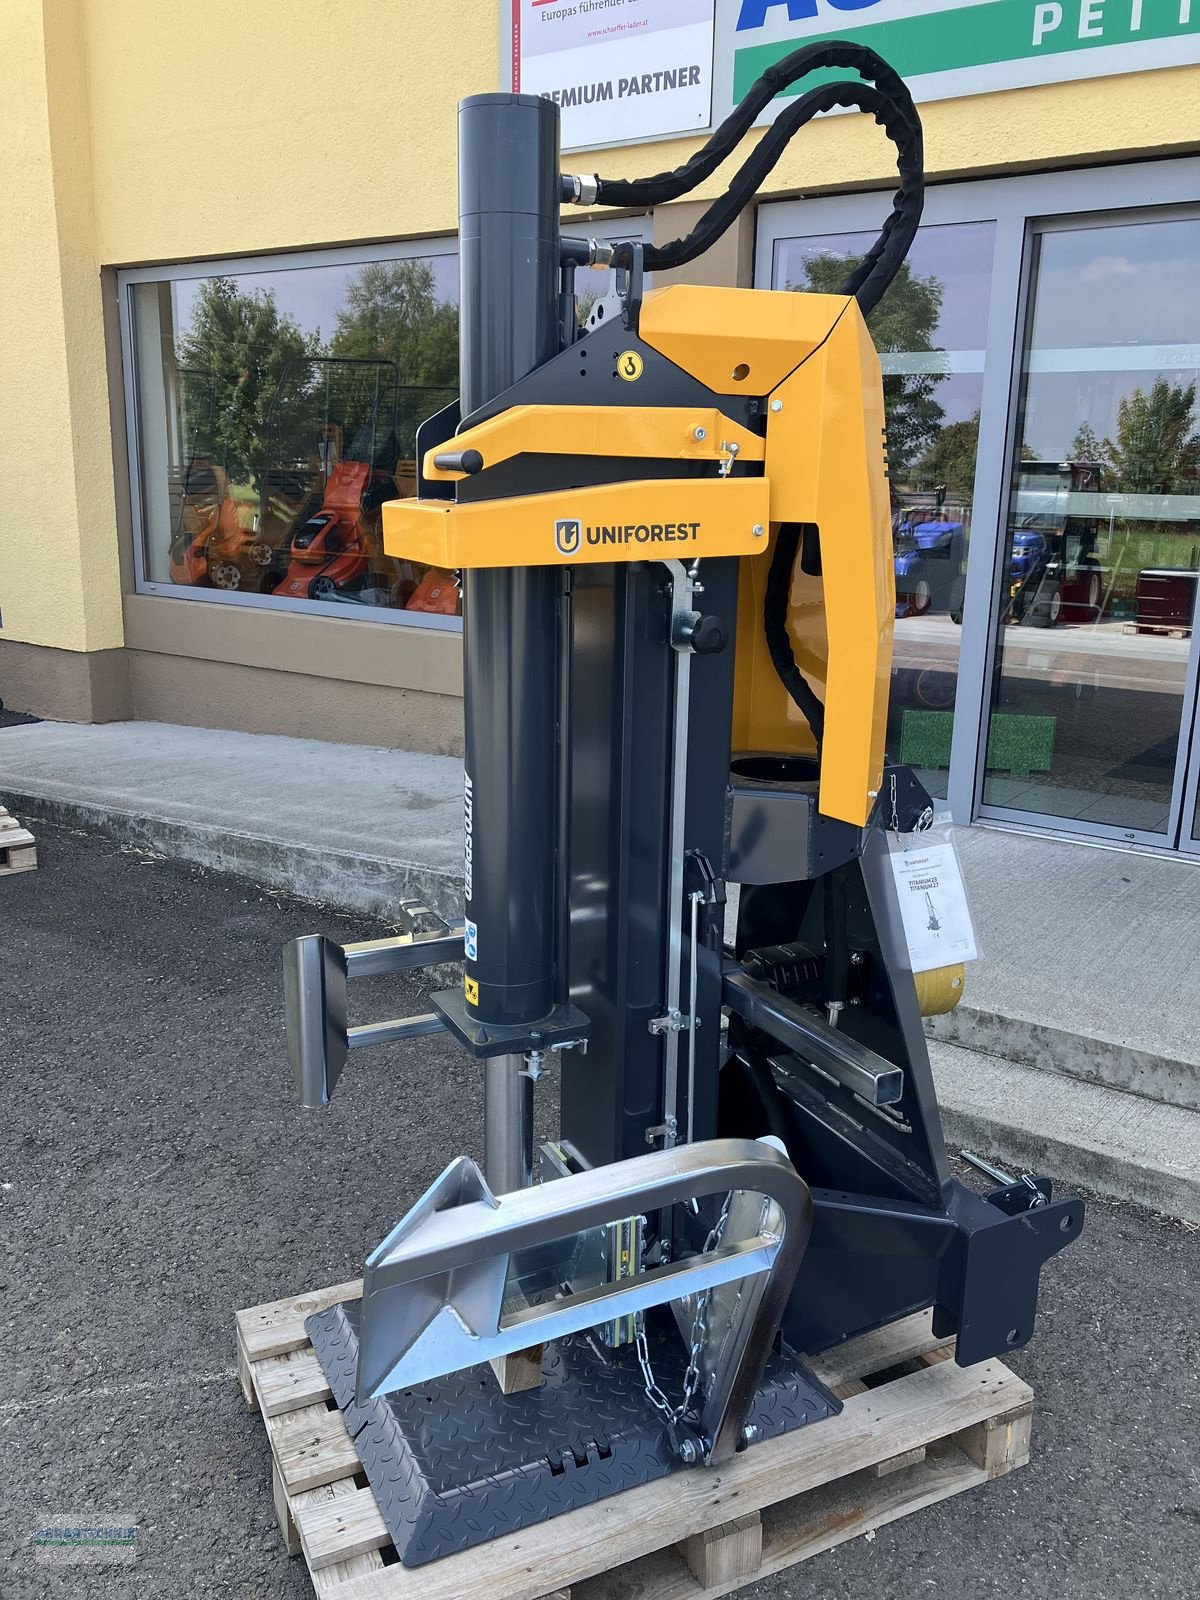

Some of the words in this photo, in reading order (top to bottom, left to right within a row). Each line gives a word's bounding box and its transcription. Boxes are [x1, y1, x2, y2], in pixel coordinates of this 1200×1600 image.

[541, 6, 577, 22] Europas
[587, 19, 648, 37] www.schaeffer-lader.at
[618, 64, 701, 98] PARTNER
[586, 522, 701, 545] UNIFOREST
[464, 770, 473, 902] AUTOSPEED
